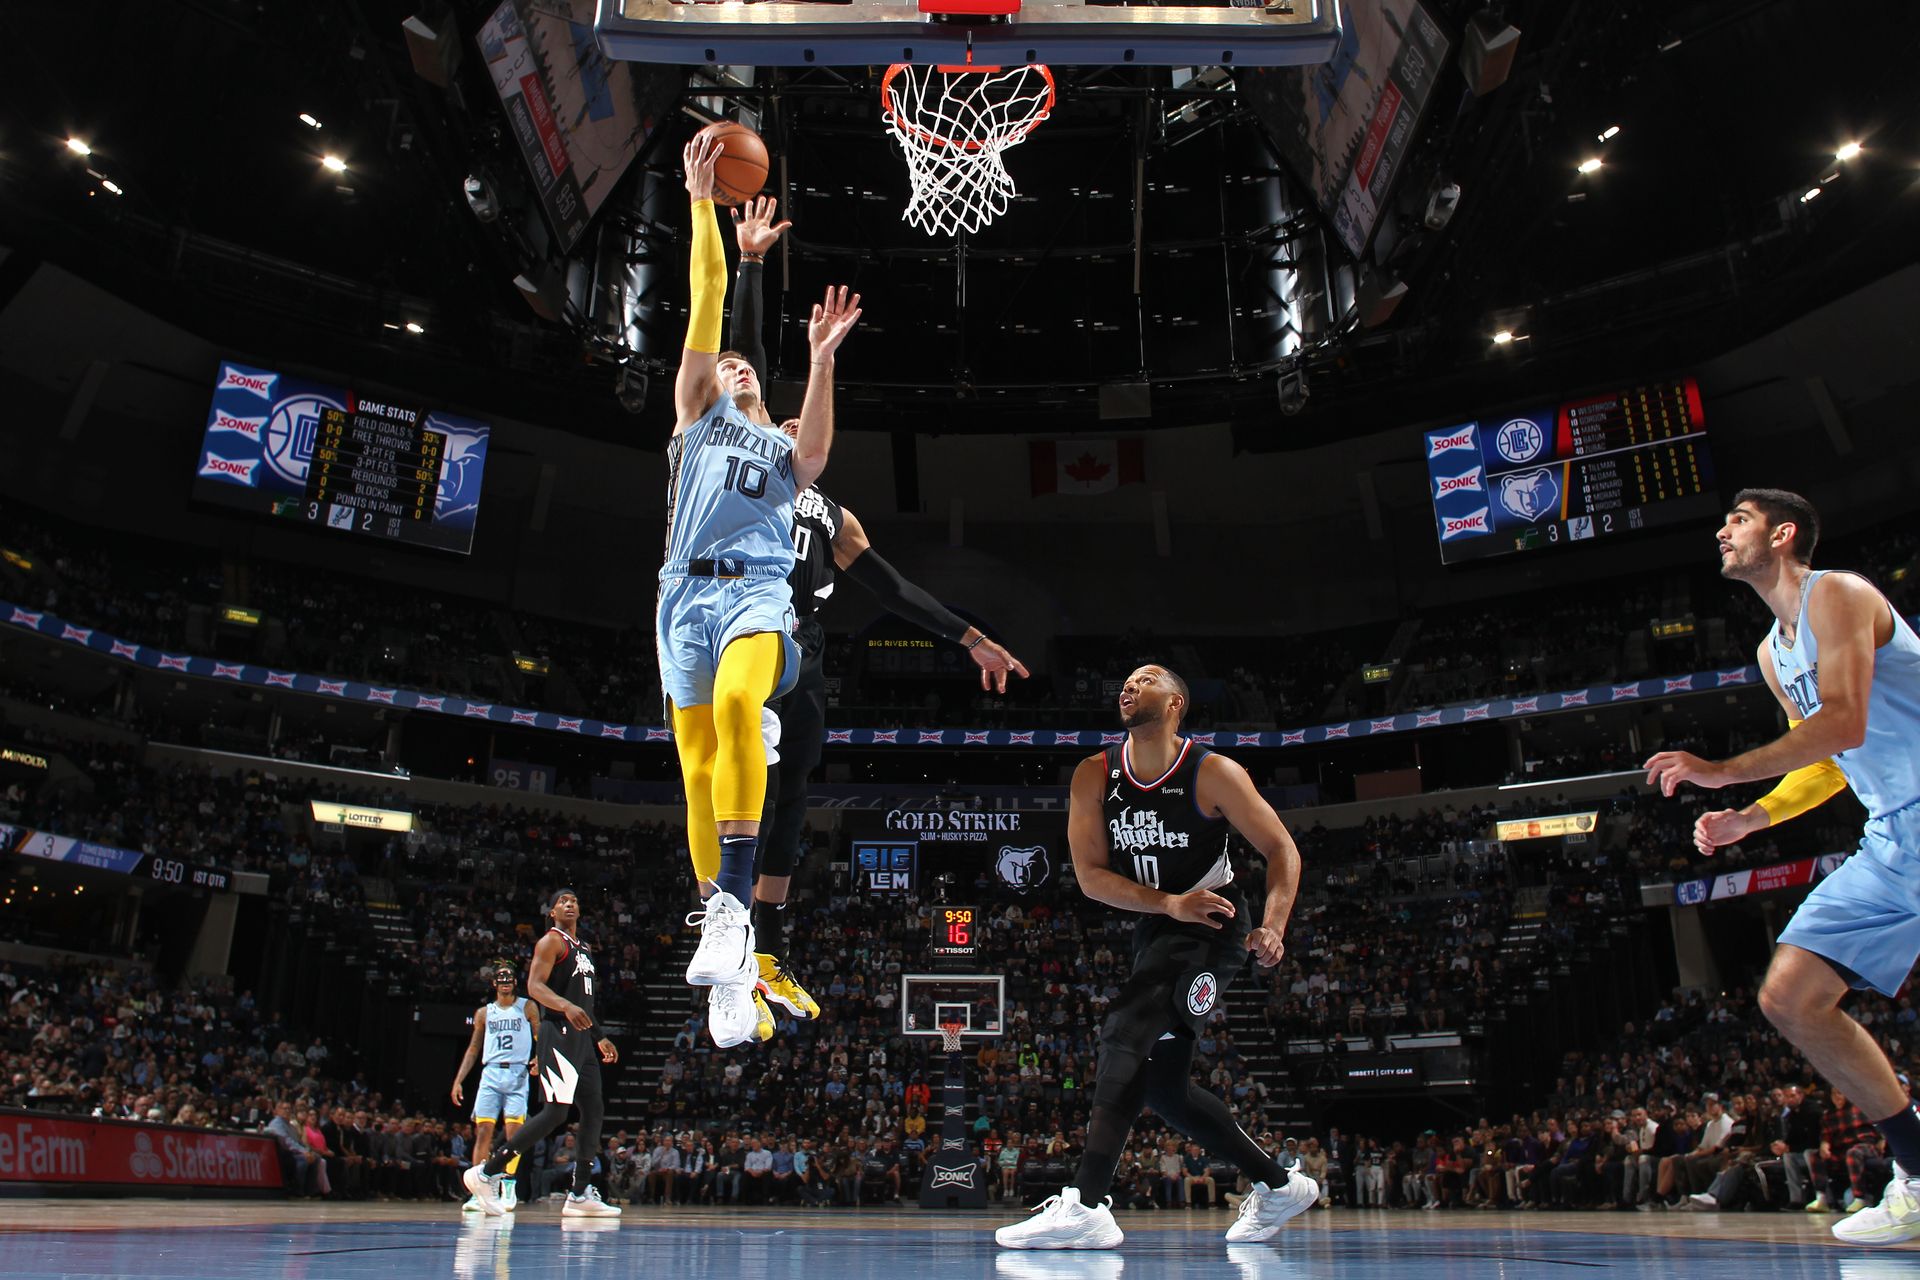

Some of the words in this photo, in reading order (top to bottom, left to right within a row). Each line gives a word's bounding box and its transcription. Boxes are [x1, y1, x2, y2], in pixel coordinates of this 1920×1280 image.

[227, 375, 268, 391] SONIC
[359, 400, 386, 417] GAME
[387, 407, 416, 422] STATS
[218, 417, 259, 433] SONIC
[327, 410, 346, 423] 50%
[353, 416, 377, 430] FIELD
[379, 422, 406, 437] GOALS
[422, 432, 439, 445] 33%
[326, 423, 343, 436] 0-0
[352, 429, 374, 444] FREE
[375, 434, 411, 452] THROWS
[421, 445, 437, 457] 0-0
[1434, 435, 1469, 451] SONIC
[362, 445, 383, 458] 3-PT
[384, 450, 396, 461] FG
[208, 460, 250, 476] SONIC
[320, 448, 338, 462] 50%
[356, 456, 376, 470] 3-PT
[376, 461, 389, 473] FG
[416, 470, 434, 483] 50%
[322, 463, 330, 474] 2
[351, 469, 399, 489] REBOUNDS
[420, 484, 426, 495] 2
[724, 456, 769, 499] 10
[1440, 476, 1476, 491] SONIC
[320, 476, 328, 487] 0
[355, 483, 390, 500] BLOCKS
[417, 496, 424, 507] 0
[308, 502, 319, 520] 3
[318, 490, 326, 500] 2
[335, 492, 367, 509] POINTS
[368, 500, 378, 511] IN
[379, 502, 403, 516] PAINT
[414, 510, 422, 520] 0
[362, 512, 373, 531] 2
[1447, 517, 1483, 532] SONIC
[1603, 514, 1614, 533] 2
[1548, 524, 1559, 542] 3
[794, 524, 812, 562] 0
[15, 612, 39, 626] SONIC
[66, 628, 88, 641] SONIC
[115, 644, 137, 657] SONIC
[869, 640, 882, 648] BIG
[884, 640, 909, 648] RIVER
[164, 657, 186, 669] SONIC
[216, 666, 240, 678] SONIC
[269, 674, 291, 685] SONIC
[1721, 672, 1744, 682] SONIC
[322, 683, 343, 693] SONIC
[1615, 687, 1637, 698] SONIC
[1667, 680, 1689, 690] SONIC
[371, 692, 392, 700] SONIC
[420, 699, 441, 708] SONIC
[1564, 695, 1585, 704] SONIC
[467, 706, 488, 715] SONIC
[1467, 708, 1487, 718] SONIC
[1515, 702, 1536, 711] SONIC
[514, 713, 534, 722] SONIC
[560, 720, 580, 729] SONIC
[1373, 720, 1393, 730] SONIC
[1420, 714, 1440, 724] SONIC
[604, 728, 624, 736] SONIC
[649, 730, 668, 738] SONIC
[1194, 735, 1215, 744] SONIC
[1238, 735, 1259, 743] SONIC
[1284, 733, 1303, 742] SONIC
[1328, 728, 1348, 737] SONIC
[1, 749, 48, 770] MINOLTA
[1111, 769, 1121, 779] 6
[1161, 786, 1184, 796] honey
[349, 813, 384, 824] LOTTERY
[886, 810, 944, 831] GOLD
[948, 810, 1020, 831] STRIKE
[1120, 806, 1157, 830] Los
[920, 832, 936, 841] SLIM
[942, 832, 969, 842] HUSKY'S
[970, 832, 988, 842] PIZZA
[1110, 819, 1190, 855] Angeles
[44, 836, 55, 857] 3
[859, 848, 910, 871] BIG
[152, 858, 184, 884] 9:50
[1134, 854, 1160, 890] 10
[209, 873, 226, 888] QTR
[1728, 876, 1737, 896] 5
[945, 910, 972, 923] 9:50
[948, 924, 969, 945] 16
[488, 1018, 522, 1035] GRIZZLIES
[497, 1035, 513, 1051] 12
[163, 1136, 262, 1181] StateFarm
[938, 1171, 970, 1182] SONIC
